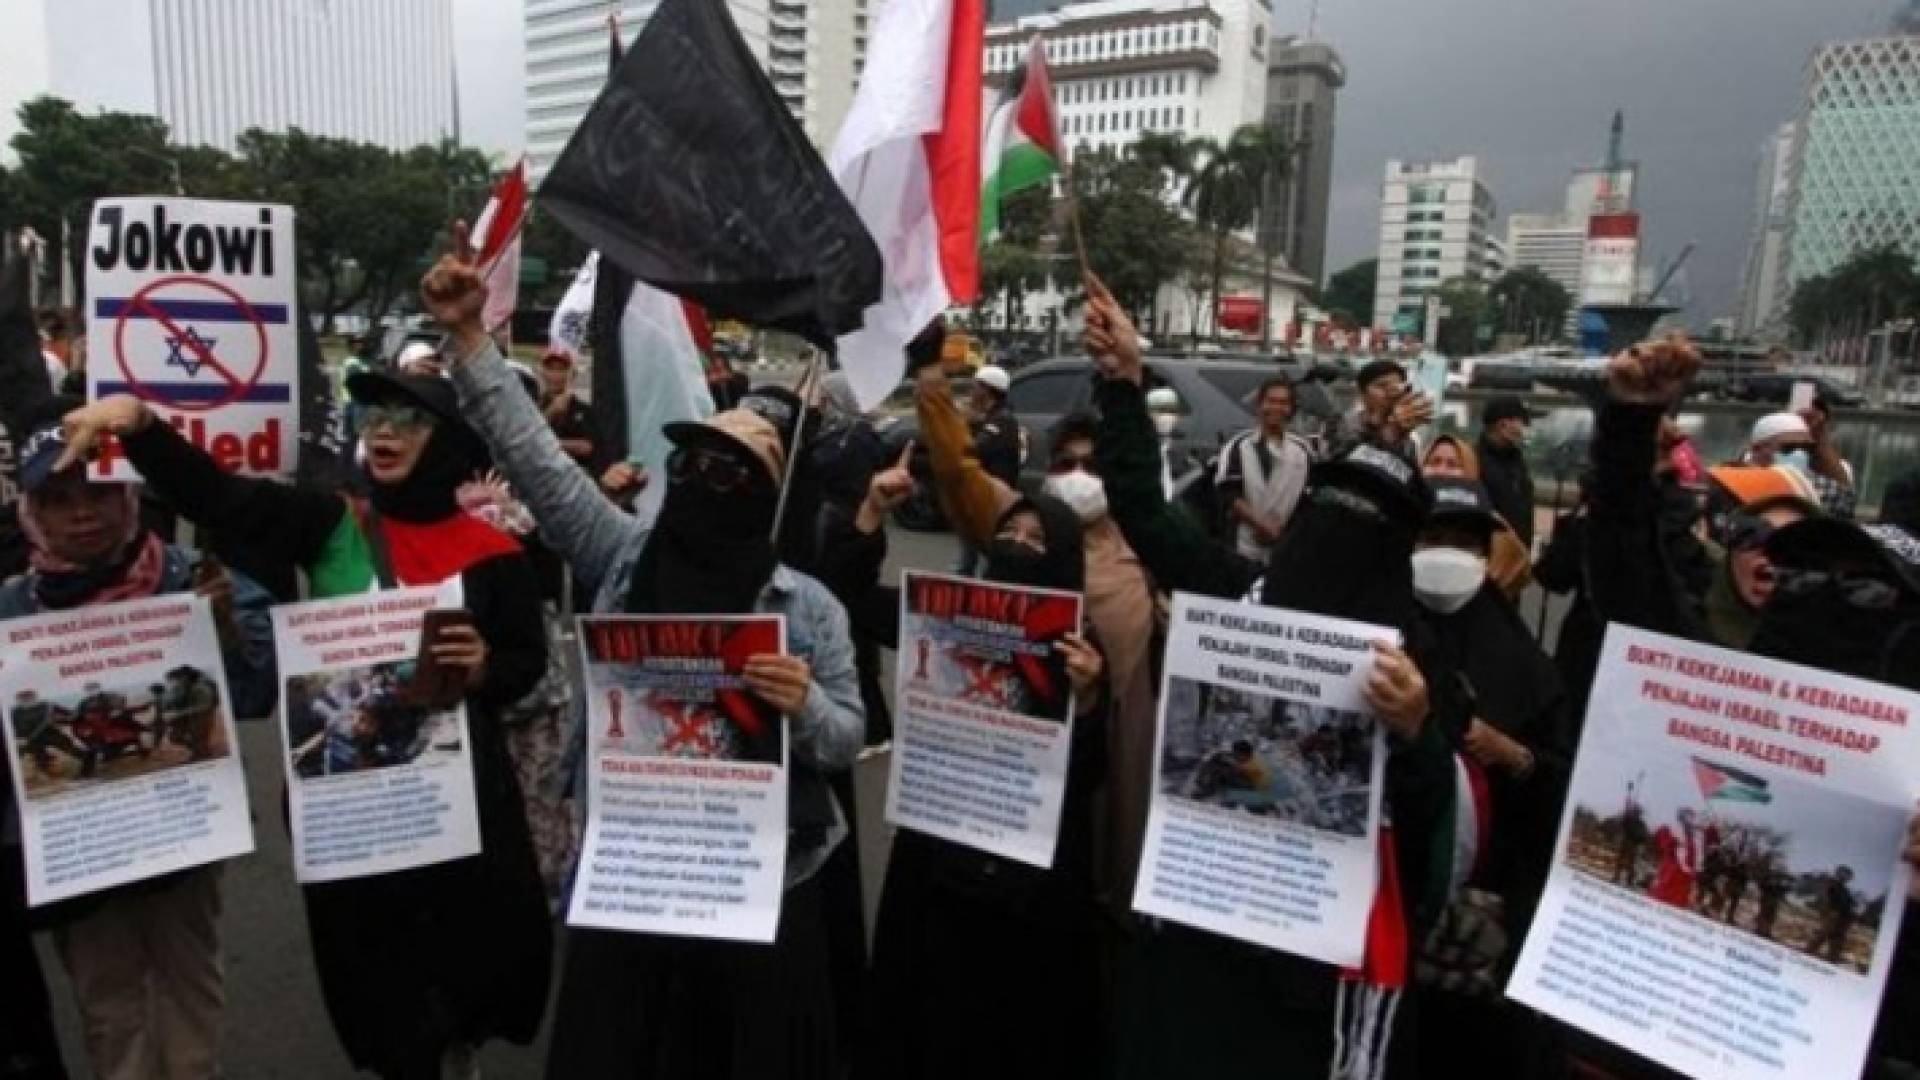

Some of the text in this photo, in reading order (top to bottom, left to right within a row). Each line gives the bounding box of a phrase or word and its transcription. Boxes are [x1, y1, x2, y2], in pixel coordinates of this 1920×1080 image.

[94, 205, 274, 277] Jokowi
[1627, 645, 1673, 671] BUKTI
[1676, 656, 1774, 694] KEKEJAMAN
[1795, 684, 1908, 726] KEBIADABAN
[1642, 680, 1881, 753] PENJAJAH ISRAEL TERHADAP
[1667, 718, 1826, 775] BANGSA PALESTINA
